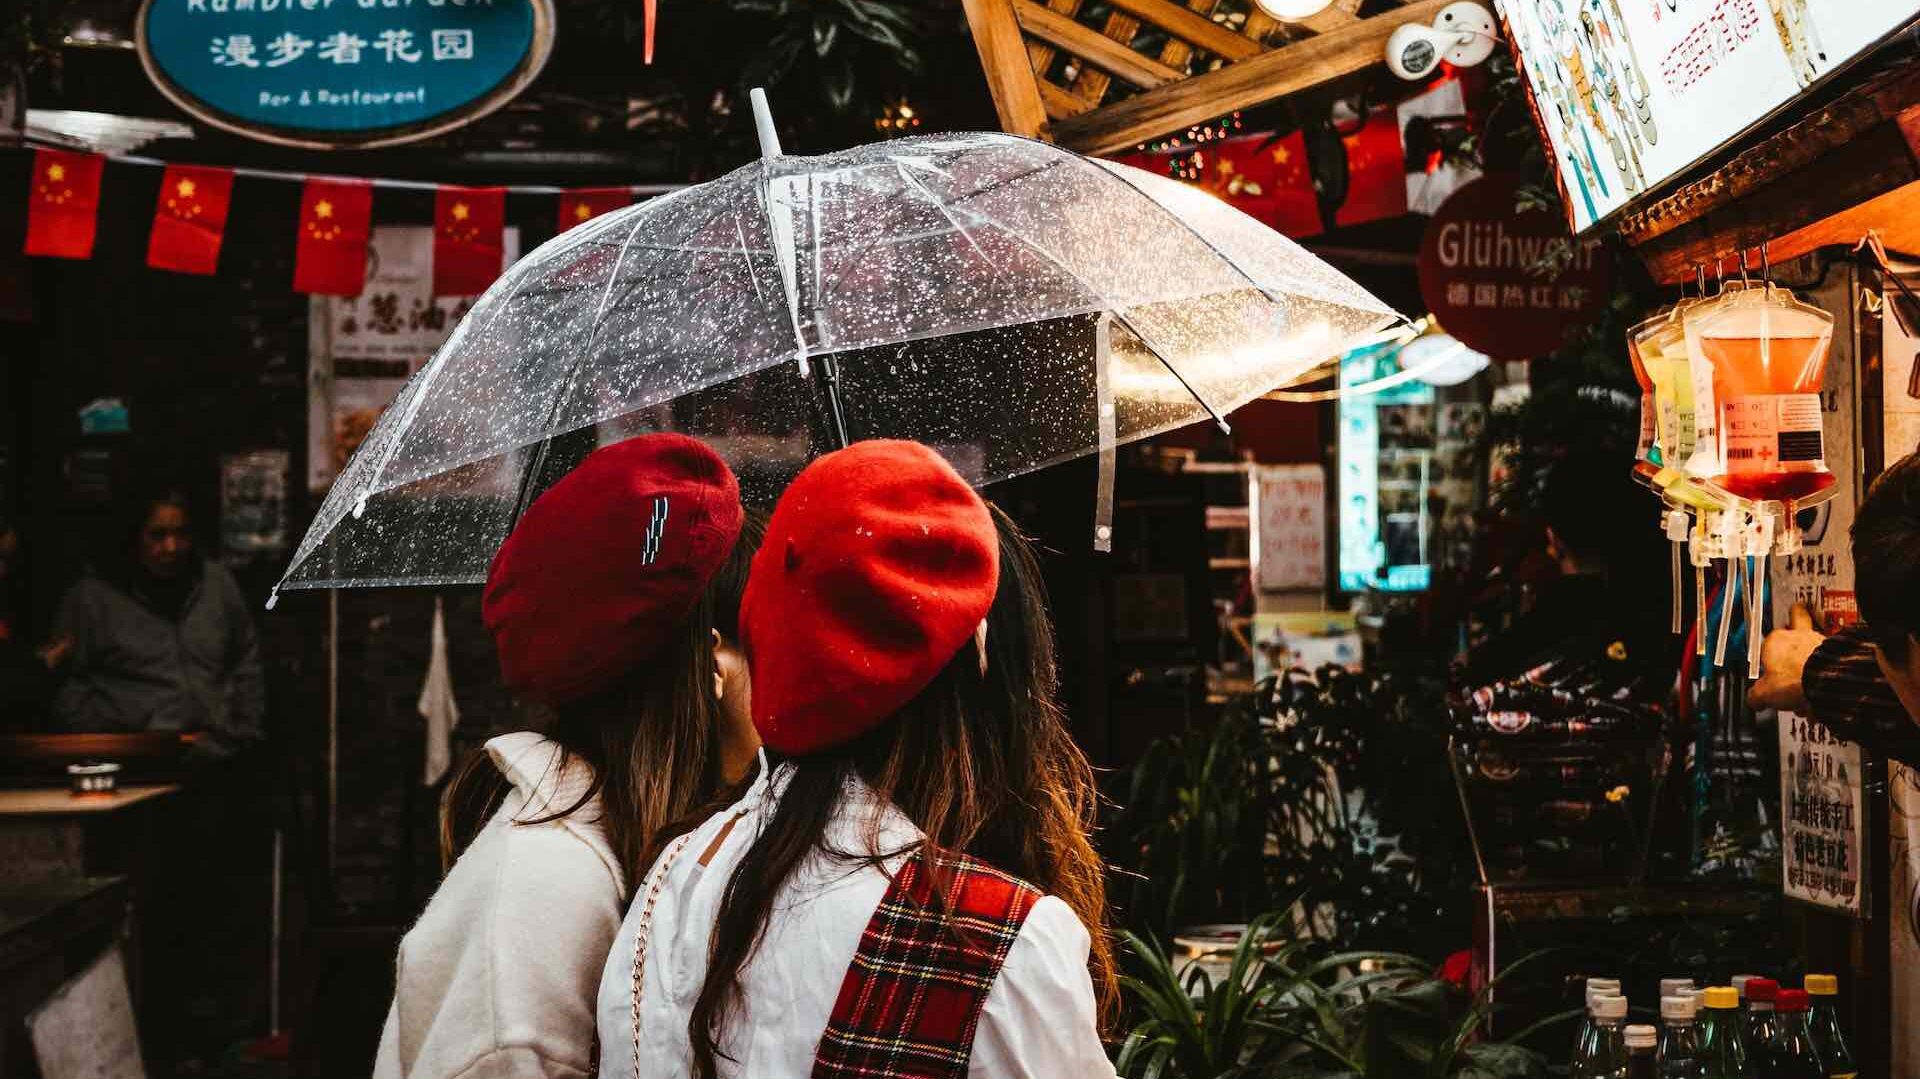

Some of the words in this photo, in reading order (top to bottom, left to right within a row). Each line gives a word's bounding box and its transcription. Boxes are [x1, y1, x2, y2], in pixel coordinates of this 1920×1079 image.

[210, 29, 474, 67] 漫步者花园
